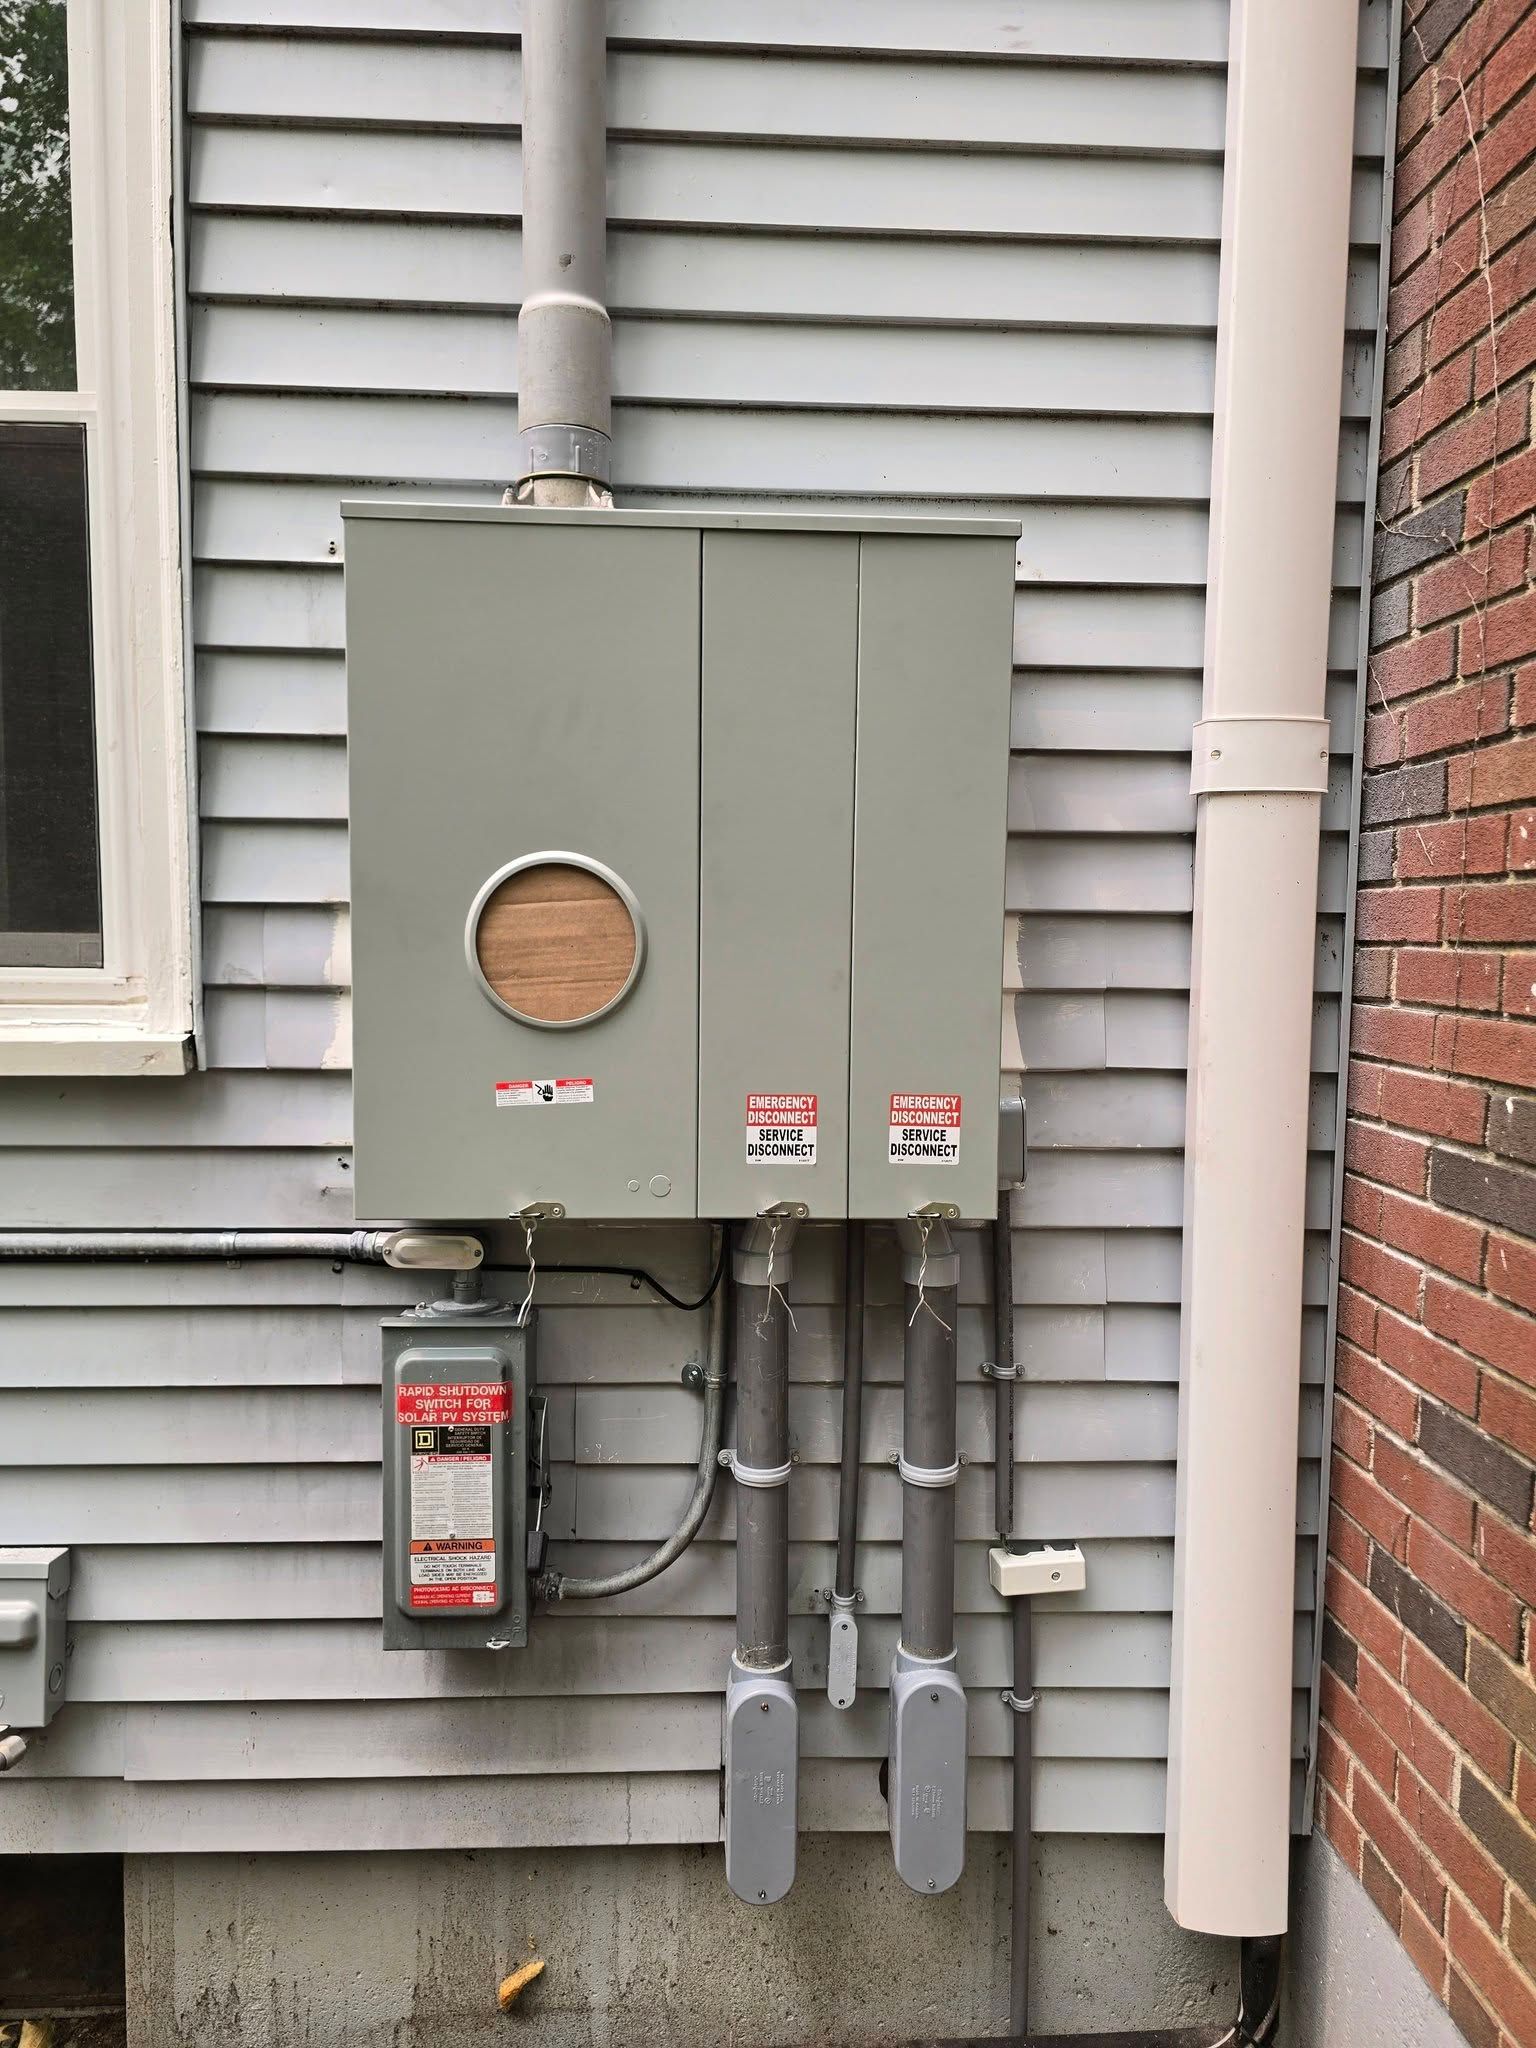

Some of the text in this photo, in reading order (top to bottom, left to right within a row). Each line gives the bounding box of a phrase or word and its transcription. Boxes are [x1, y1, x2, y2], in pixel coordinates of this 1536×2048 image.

[749, 1095, 815, 1110] EMERGENCY
[893, 1095, 959, 1110] EMERGENCY
[747, 1110, 816, 1125] DISCONNECT
[891, 1110, 959, 1125] DISCONNECT
[758, 1129, 804, 1142] SERVICE
[902, 1128, 947, 1142] SERVICE
[747, 1143, 815, 1157] DISCONNECT
[890, 1143, 958, 1157] DISCONNECT
[398, 1385, 507, 1397] RAPID SHUTDOWN
[415, 1398, 491, 1410] SWITCH FOR
[398, 1410, 510, 1423] SOLAR PV SYSTEM
[436, 1542, 482, 1550] WARNING
